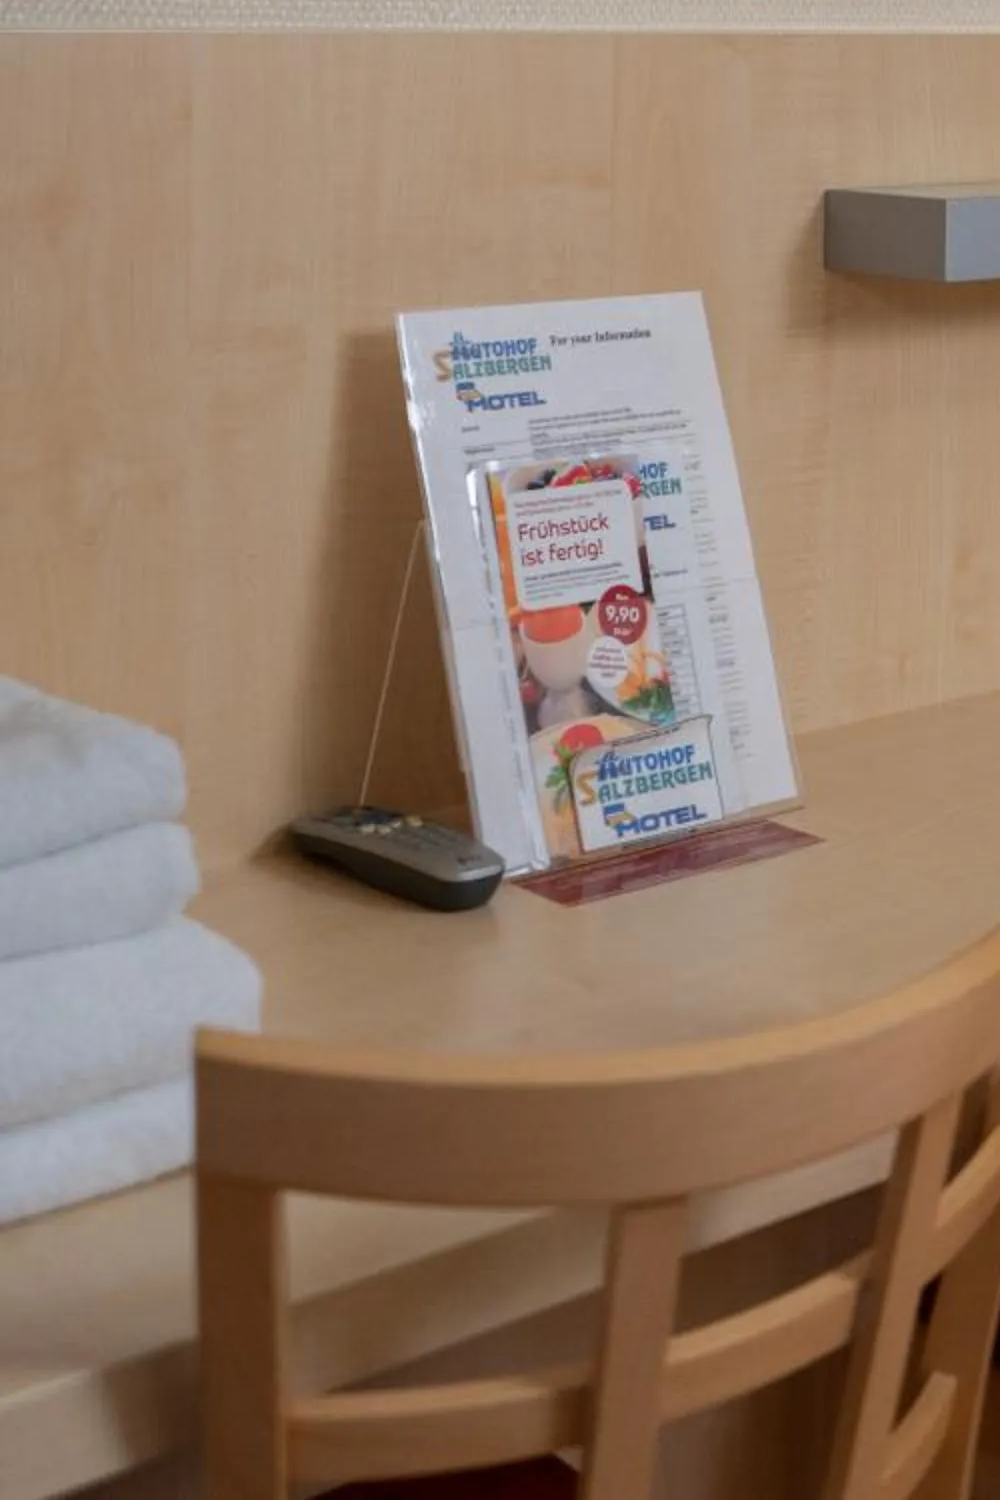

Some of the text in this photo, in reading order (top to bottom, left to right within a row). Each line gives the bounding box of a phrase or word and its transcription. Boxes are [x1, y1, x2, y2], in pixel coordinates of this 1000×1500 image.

[549, 334, 568, 347] For
[595, 328, 652, 342] Information
[466, 391, 547, 413] MOTEL
[517, 512, 610, 542] Frühstück
[521, 538, 605, 567] ist fertig!
[605, 604, 640, 625] 9,90
[575, 761, 713, 806] SALZBERGEN
[616, 804, 708, 838] MOTEL
